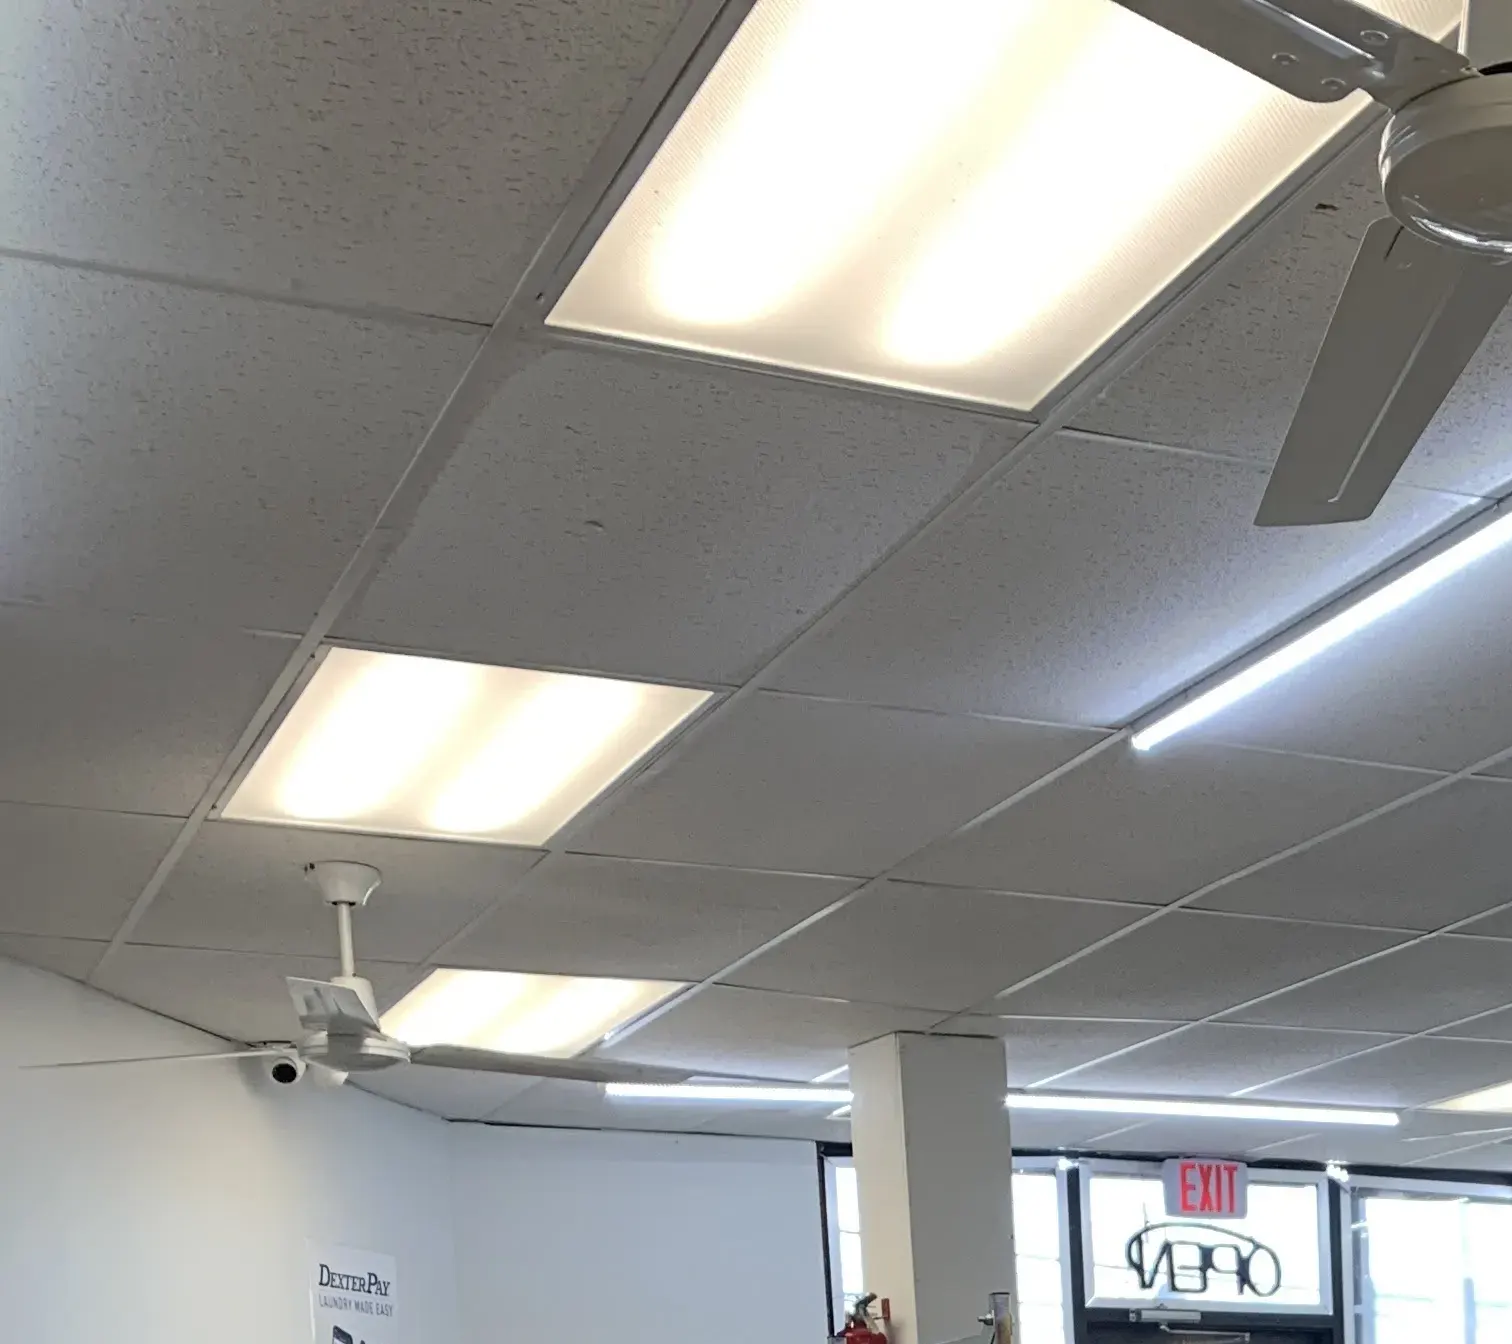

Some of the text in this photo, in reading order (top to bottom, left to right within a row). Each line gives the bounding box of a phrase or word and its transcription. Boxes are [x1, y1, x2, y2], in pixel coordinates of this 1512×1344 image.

[1179, 1161, 1238, 1214] EXIT
[318, 1294, 393, 1318] LAUNDRY MADE EASY
